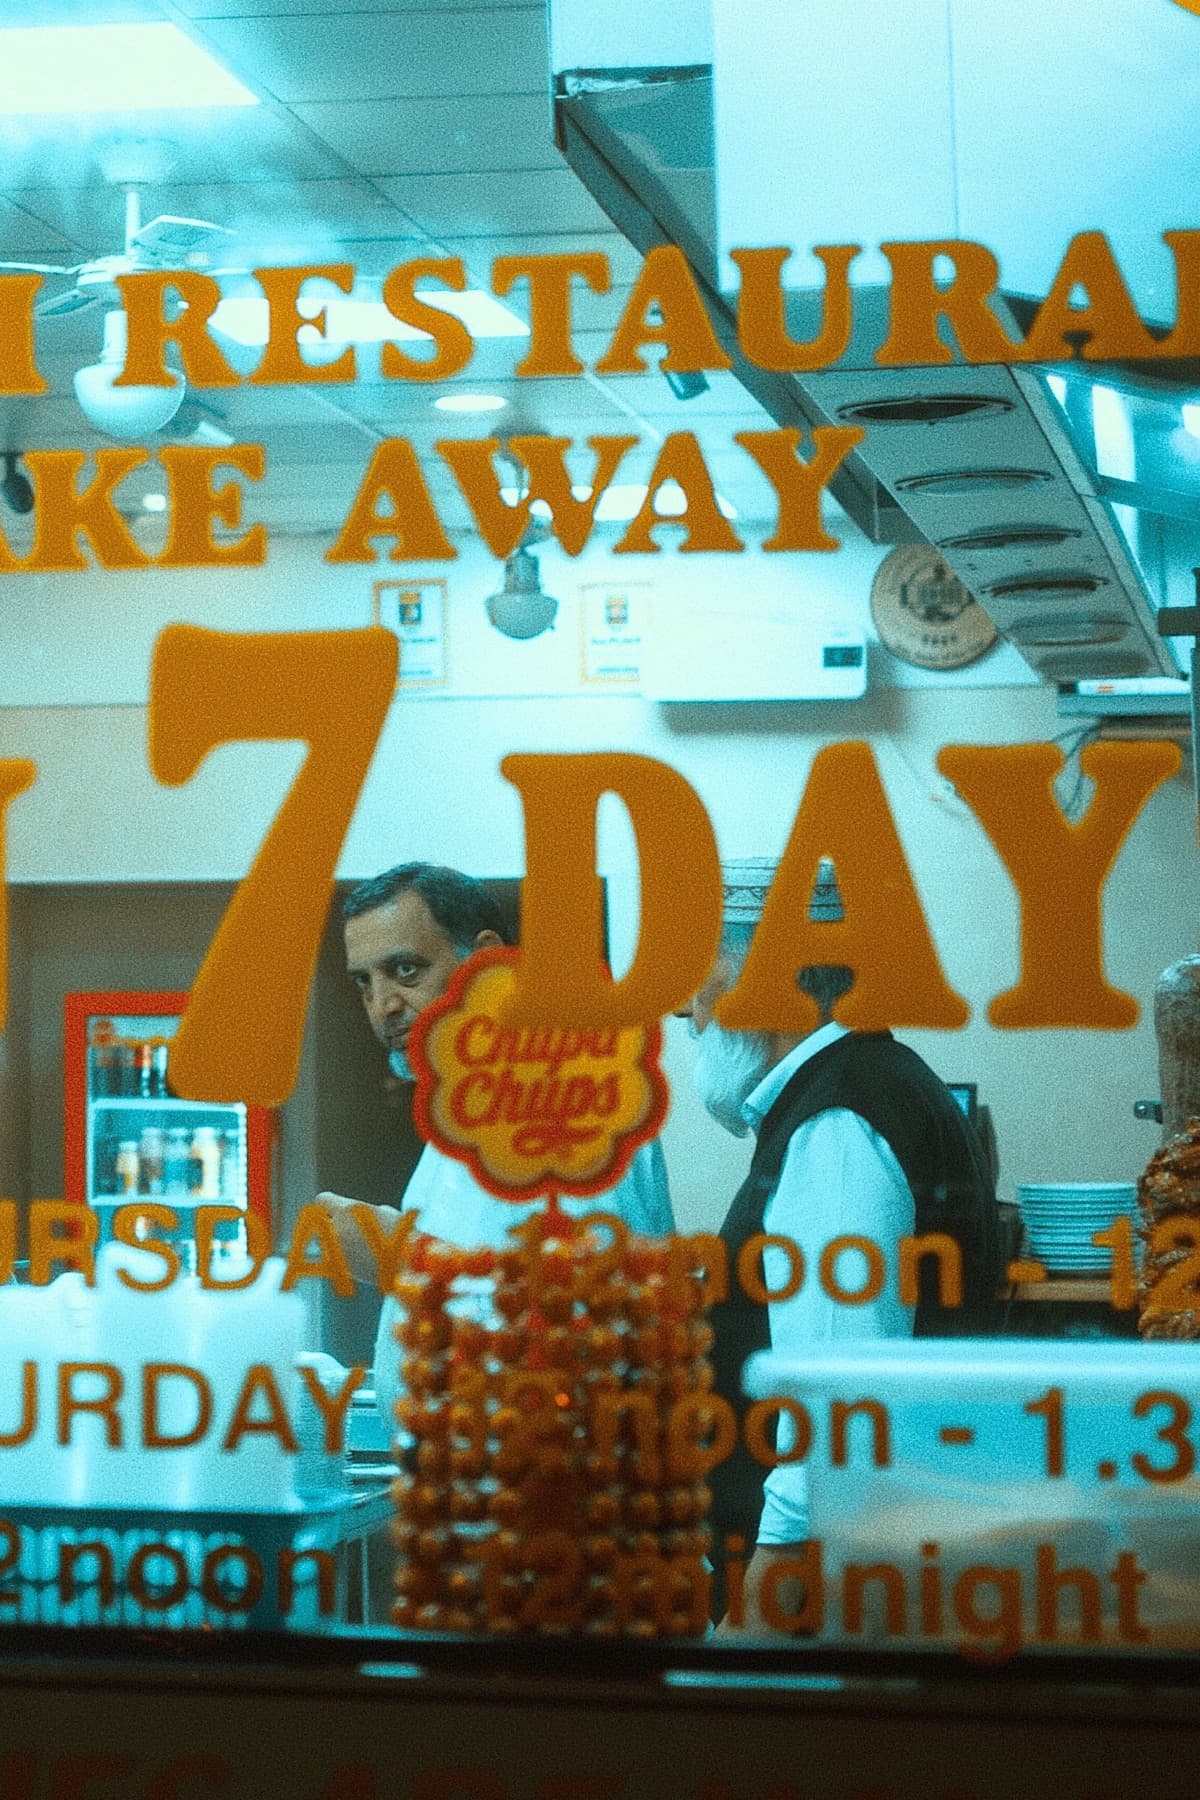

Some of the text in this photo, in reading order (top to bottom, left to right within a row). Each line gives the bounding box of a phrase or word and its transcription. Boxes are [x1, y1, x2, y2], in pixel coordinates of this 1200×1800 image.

[323, 427, 866, 561] AWAY
[149, 623, 399, 1108] 7
[500, 740, 1182, 1032] DAY
[451, 1067, 622, 1130] Chups
[666, 1230, 965, 1308] noon
[592, 1391, 892, 1476] noon
[612, 1533, 1150, 1668] midnight
